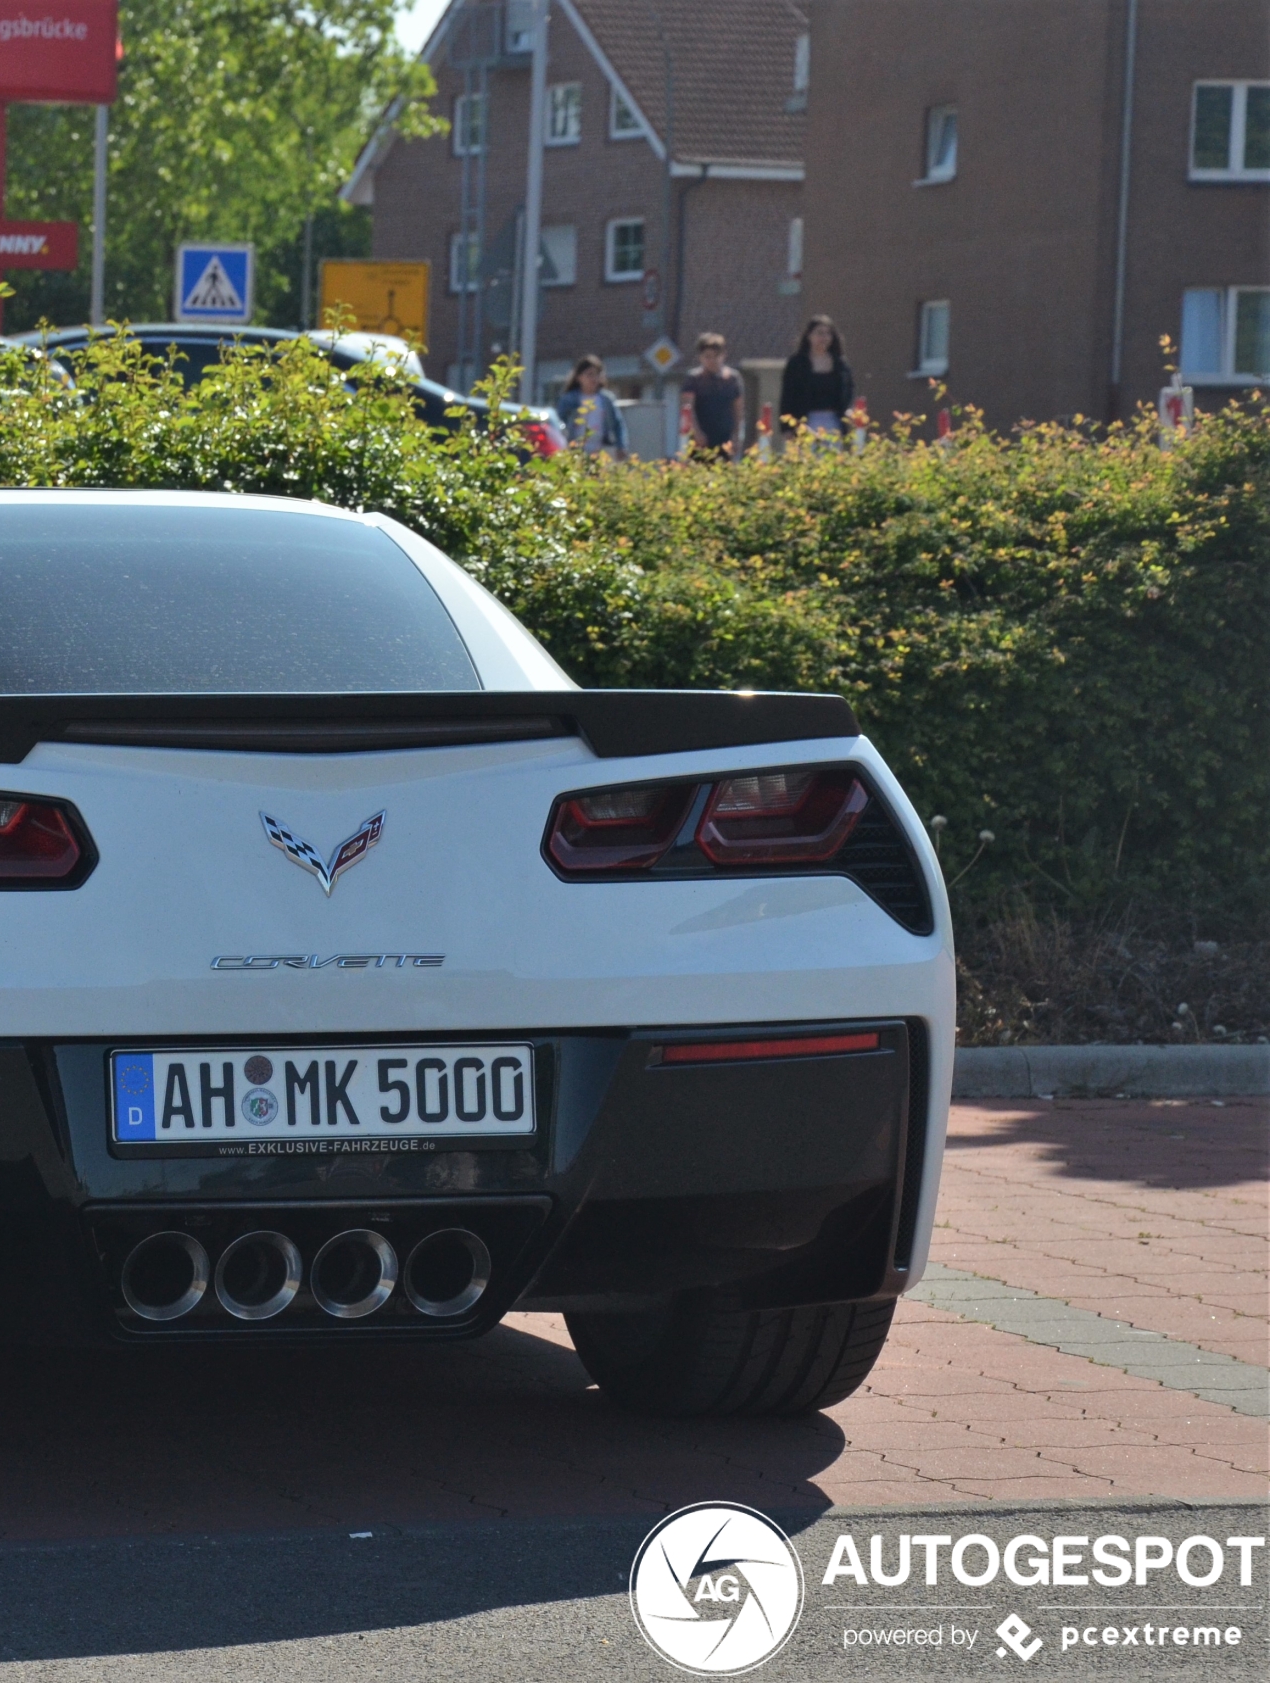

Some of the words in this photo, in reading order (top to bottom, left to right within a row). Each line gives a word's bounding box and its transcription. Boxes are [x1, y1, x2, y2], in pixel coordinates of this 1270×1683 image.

[210, 953, 446, 970] CORVETTE
[161, 1062, 236, 1129] AH
[285, 1059, 360, 1126] MK
[377, 1056, 525, 1124] 5000
[128, 1106, 144, 1126] D
[218, 1139, 436, 1156] www.EXKLUSIVE-FAHRZEUGE.de
